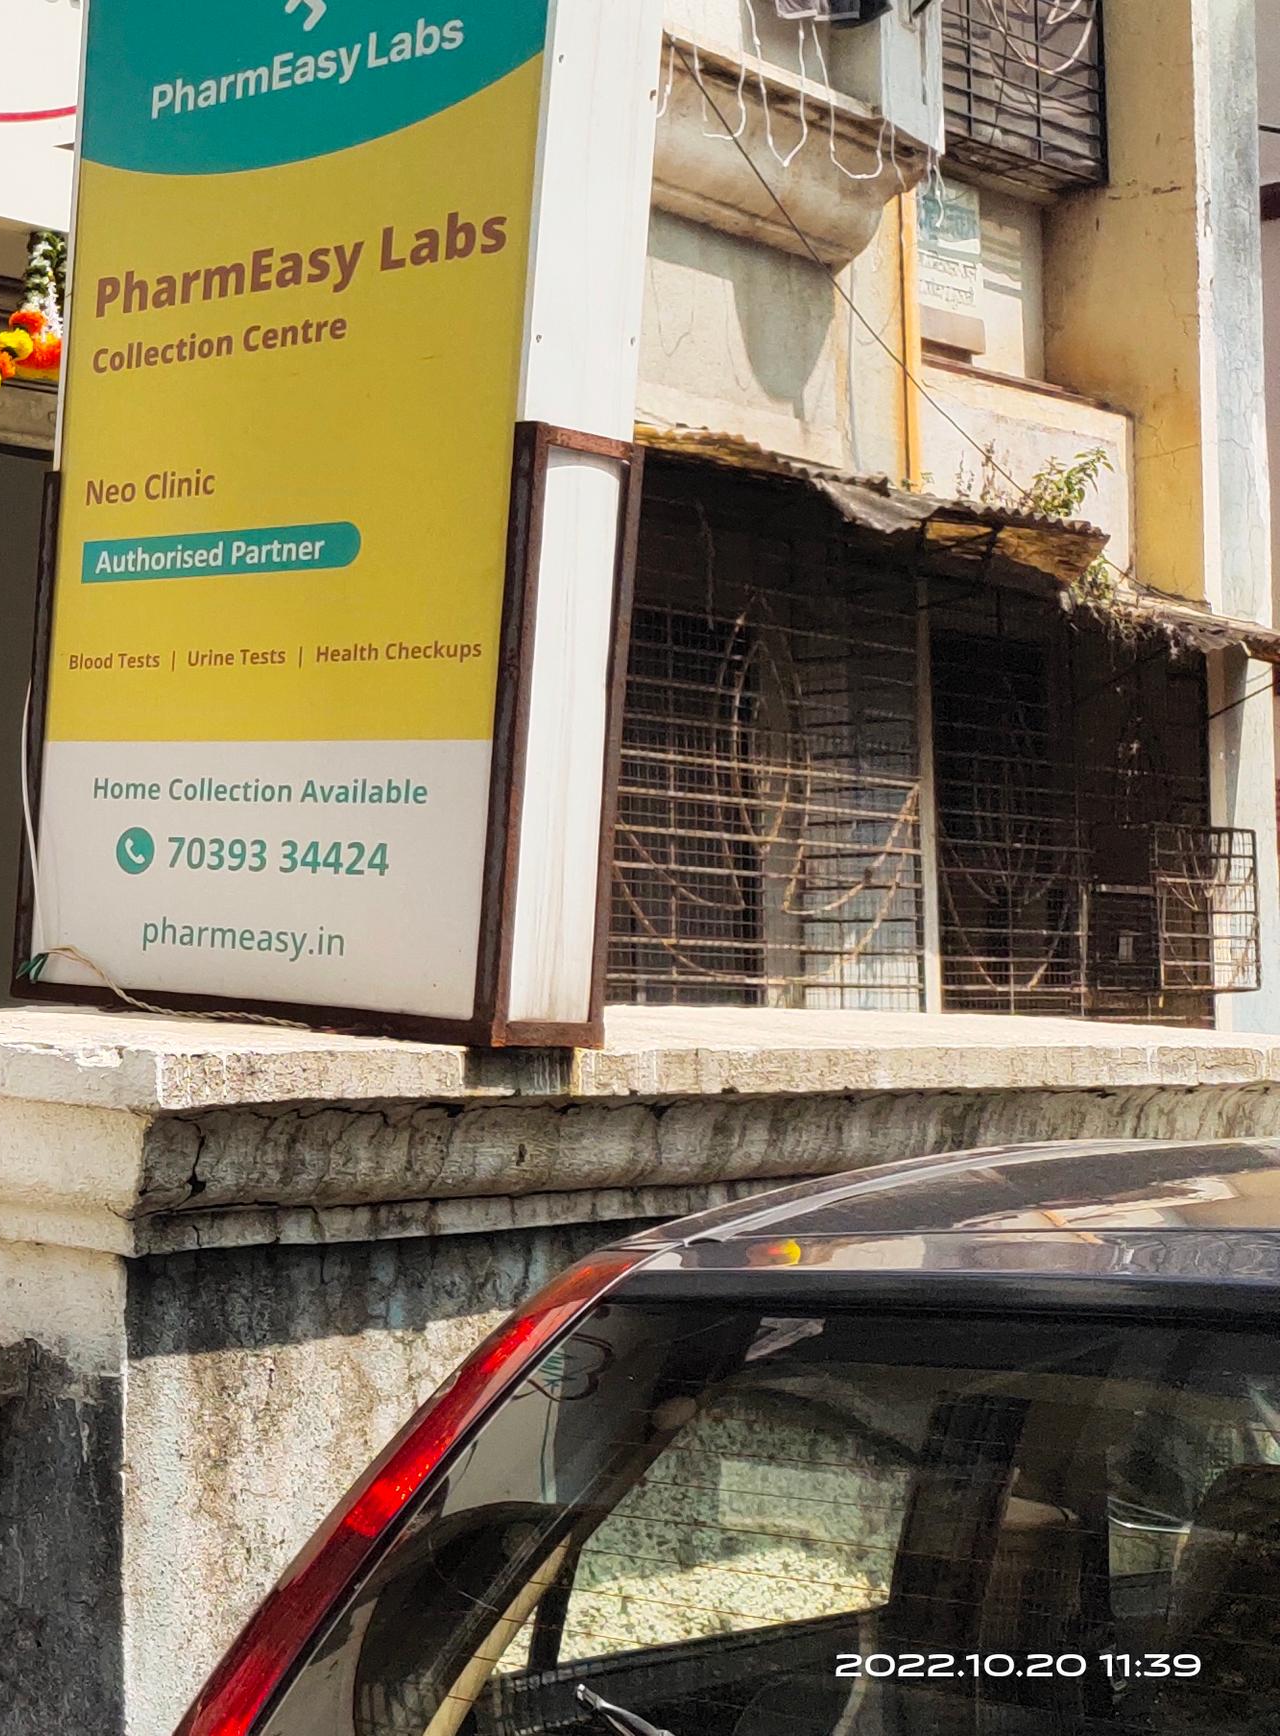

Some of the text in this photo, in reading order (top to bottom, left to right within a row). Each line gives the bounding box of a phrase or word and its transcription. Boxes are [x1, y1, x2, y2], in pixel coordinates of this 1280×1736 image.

[151, 17, 464, 119] PharmEasy Labs
[95, 211, 508, 318] PharmEasy Labs
[92, 318, 348, 374] Collection Centre
[85, 468, 216, 506] Neo Clinic
[95, 538, 325, 574] Authorised Partner
[69, 653, 113, 670] Blood
[118, 652, 160, 669] Tests
[187, 649, 235, 667] Urine
[240, 646, 286, 666] Tests
[316, 644, 379, 663] Health
[385, 641, 482, 663] Checkups
[93, 777, 429, 804] Home Collection Available
[167, 836, 390, 877] 70393 34424
[143, 916, 345, 961] pharmeasy.in
